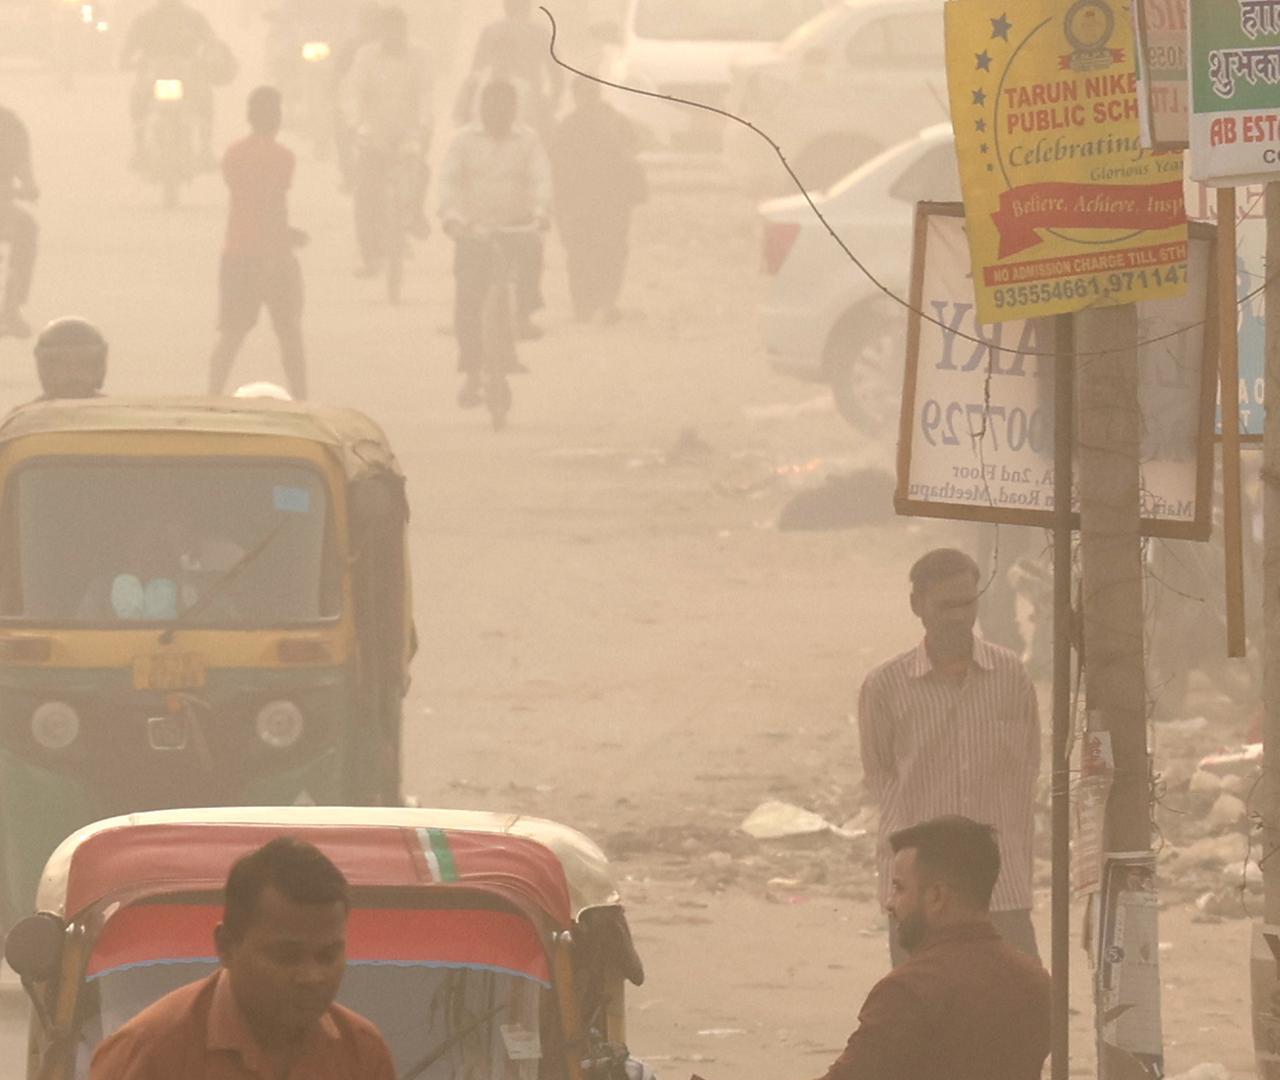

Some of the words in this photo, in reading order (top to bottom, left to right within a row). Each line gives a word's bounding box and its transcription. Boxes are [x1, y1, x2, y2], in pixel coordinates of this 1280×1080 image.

[1004, 80, 1079, 109] TARUN
[1007, 105, 1085, 134] PUBLIC
[1210, 117, 1237, 148] AB
[1090, 163, 1149, 181] Glorious
[993, 268, 1009, 283] NO
[1013, 260, 1072, 280] ADMISSION
[1075, 253, 1125, 273] CHARGE
[1128, 250, 1157, 265] TILL
